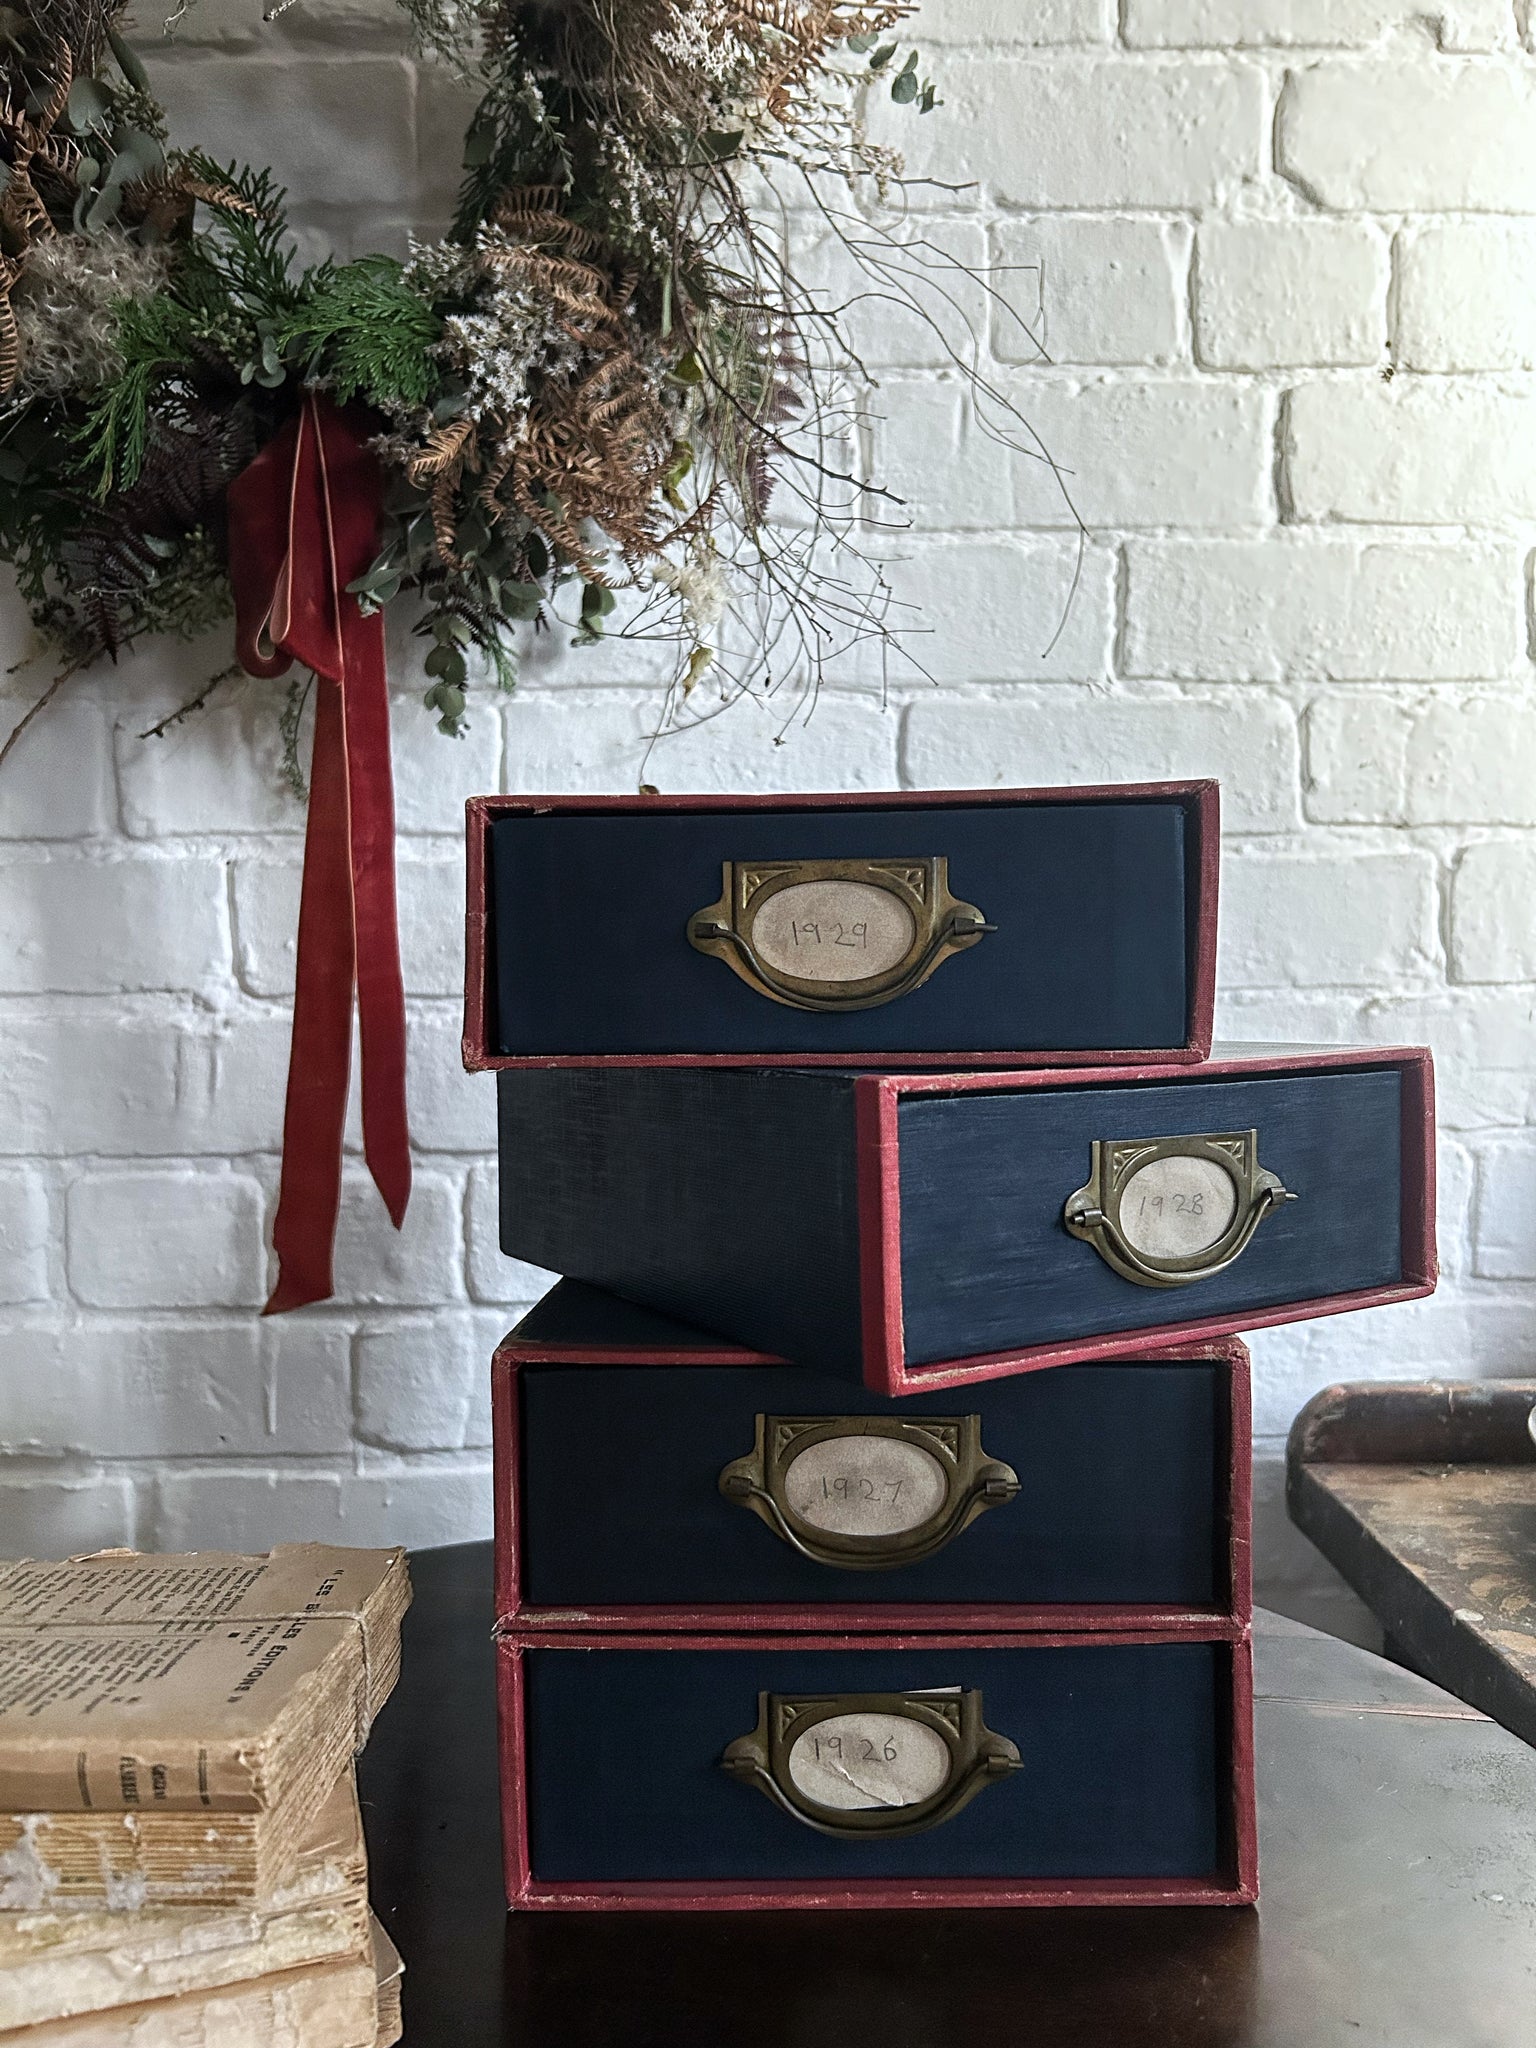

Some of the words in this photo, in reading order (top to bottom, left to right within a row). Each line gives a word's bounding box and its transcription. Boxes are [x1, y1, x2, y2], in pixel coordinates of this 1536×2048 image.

[791, 920, 868, 949] 1929
[1138, 1192, 1204, 1217] 1928
[821, 1476, 904, 1503] 1927
[315, 1578, 338, 1596] LES
[281, 1603, 321, 1639] BLES
[234, 1645, 288, 1691] ÉDITIONS
[813, 1734, 898, 1763] 1926
